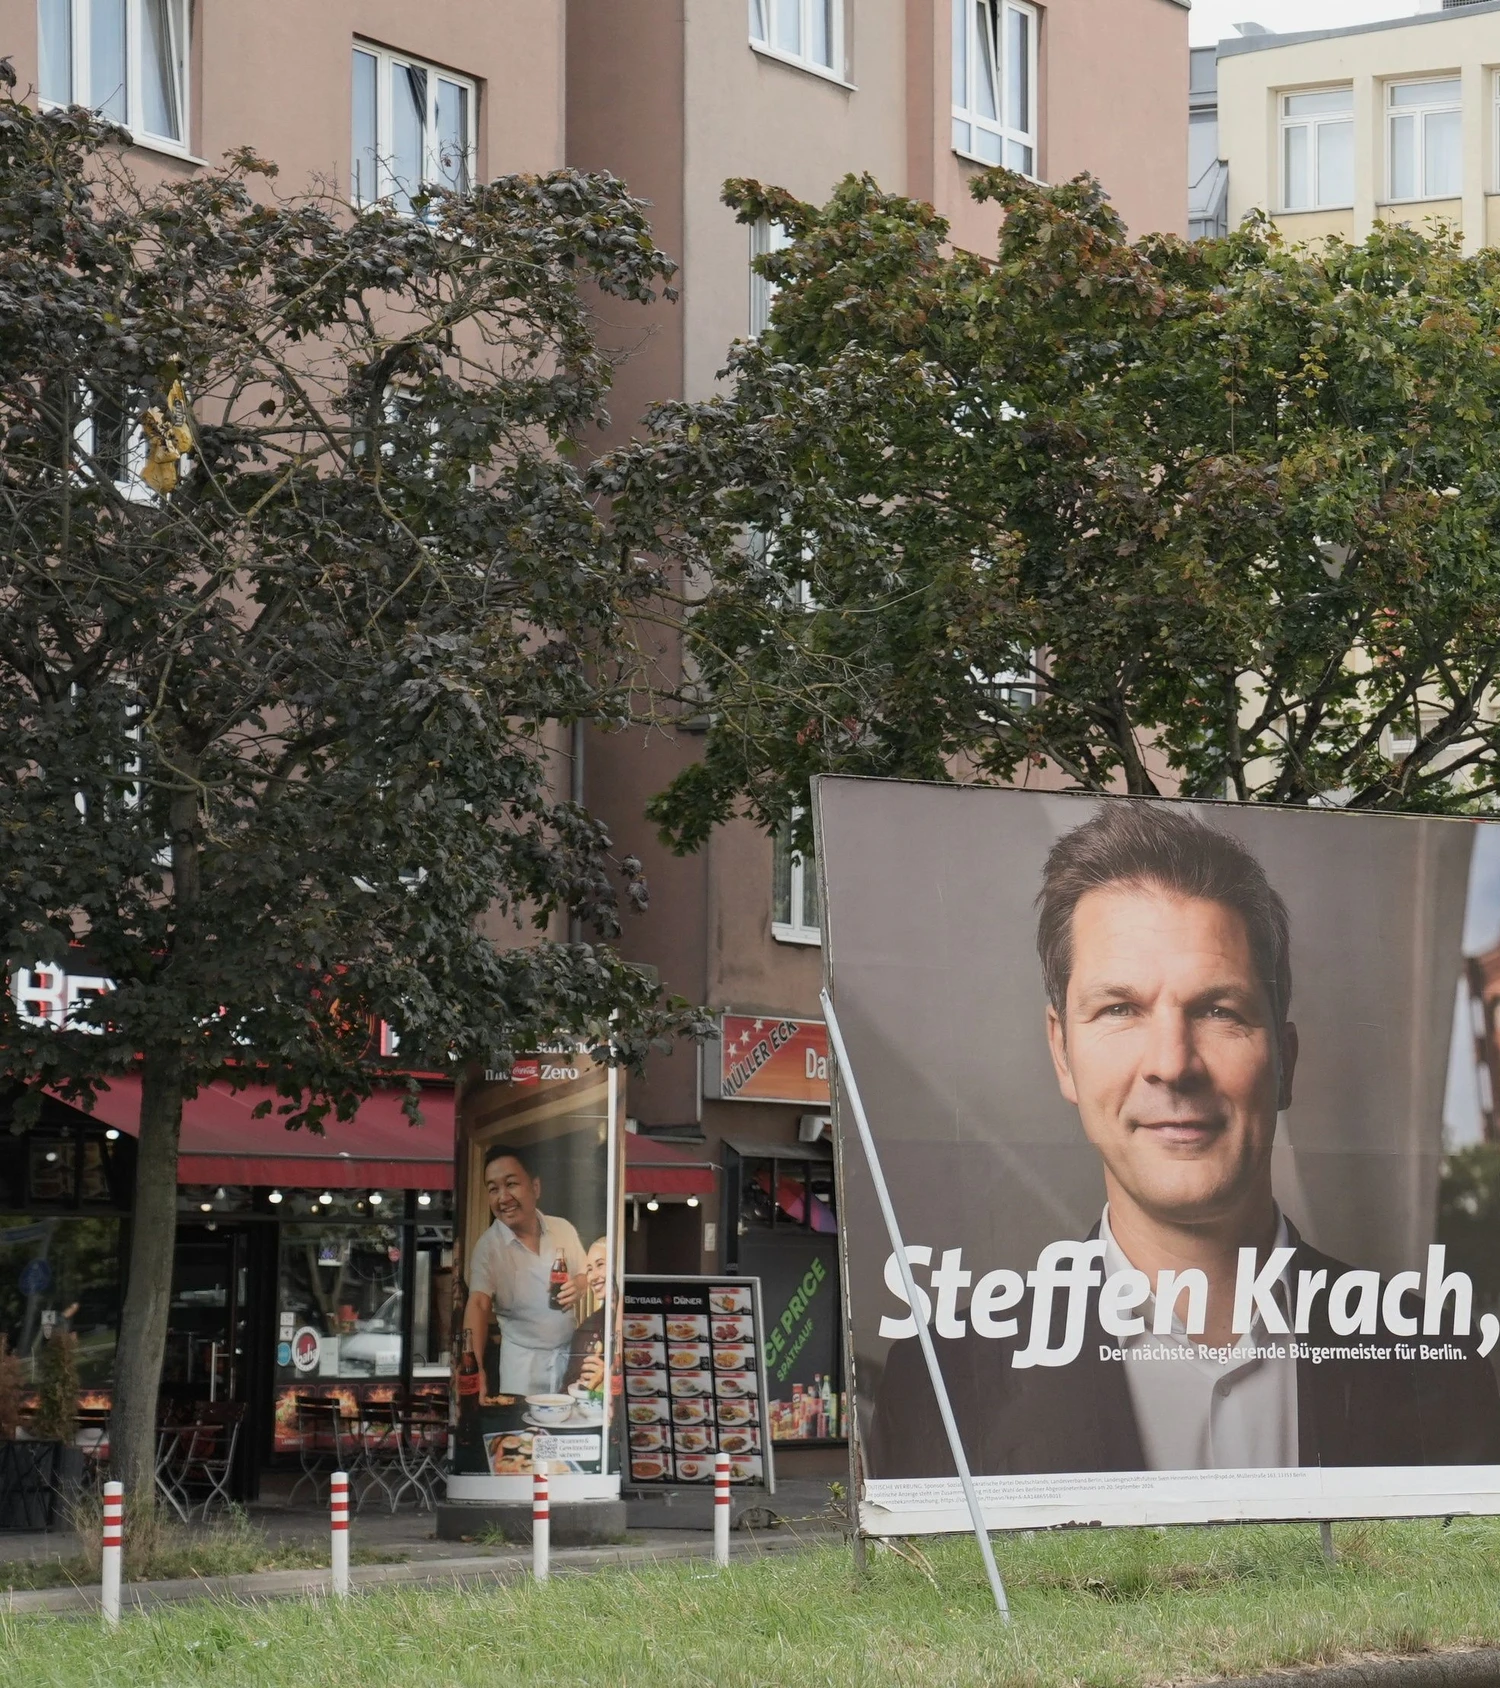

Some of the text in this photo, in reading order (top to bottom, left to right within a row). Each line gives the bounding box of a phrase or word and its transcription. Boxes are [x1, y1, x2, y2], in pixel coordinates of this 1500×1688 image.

[540, 1064, 580, 1080] Zero
[721, 1020, 800, 1098] MÜLLER ECK
[780, 1257, 827, 1335] PRICE
[878, 1239, 1210, 1368] Steffen
[1231, 1244, 1500, 1358] Krach,
[776, 1317, 815, 1383] SPÄTKAUF
[1098, 1342, 1467, 1365] Der nächste Regierende Bügermeister für Berlin.
